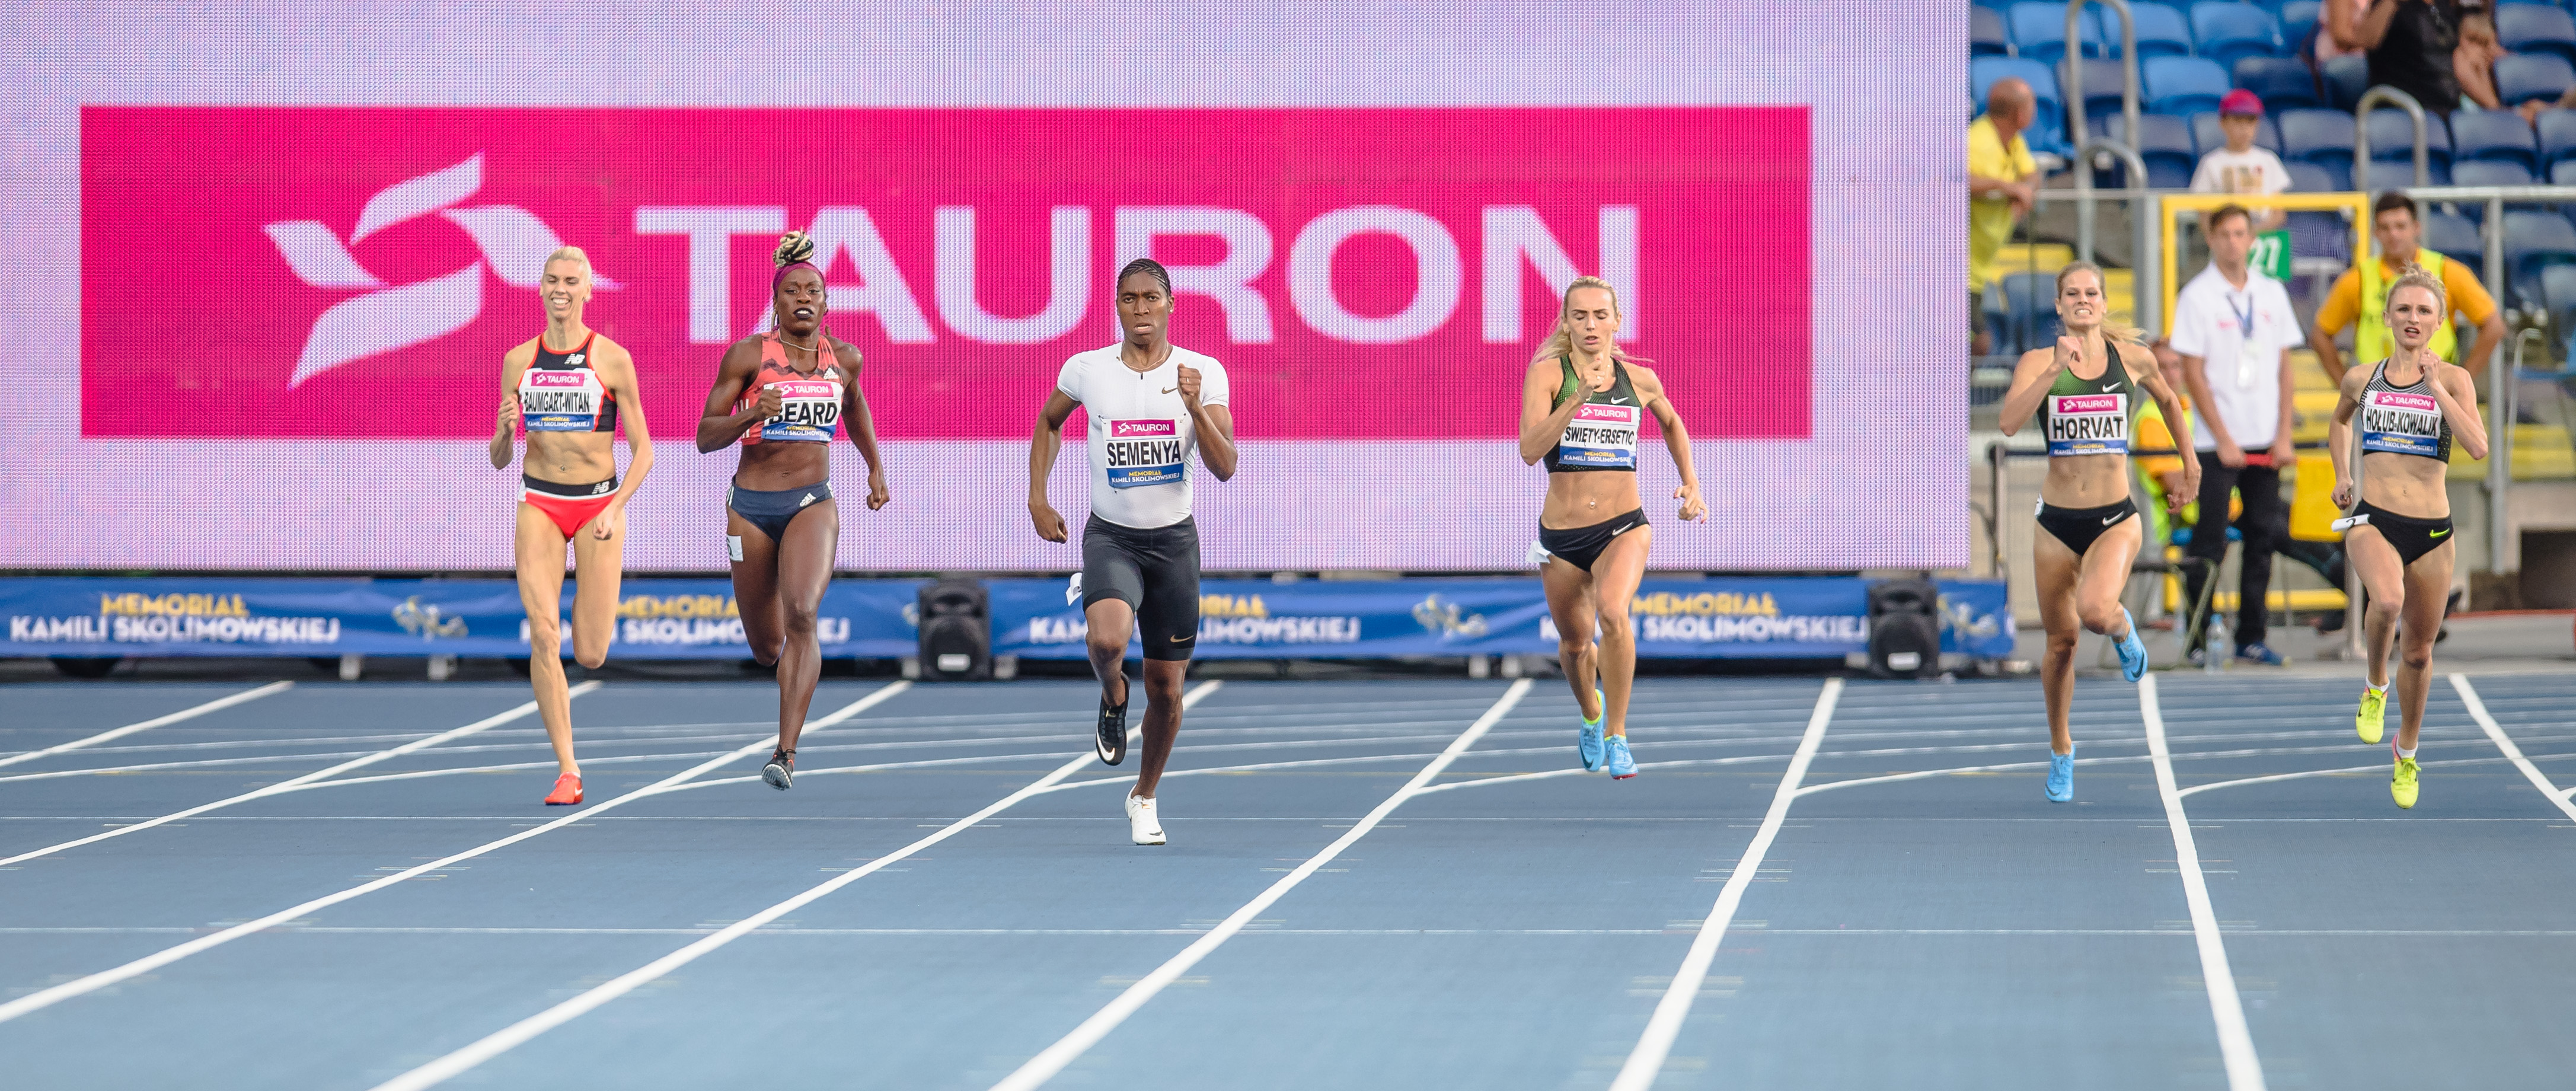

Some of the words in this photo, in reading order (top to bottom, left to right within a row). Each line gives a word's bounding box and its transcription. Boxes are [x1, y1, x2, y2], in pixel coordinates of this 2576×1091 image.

[634, 205, 1640, 344] TAURON
[547, 375, 580, 384] TAURON
[524, 391, 590, 412] BAUMGART-WITAN
[2076, 400, 2112, 409] TAURON
[2395, 397, 2431, 407] TAURON
[769, 401, 838, 425] BEARD
[1593, 409, 1628, 419] TAURON
[1131, 423, 1170, 432] TAURON
[2052, 416, 2124, 439] HORVAT
[1106, 440, 1182, 467] SEMENYA
[1132, 473, 1180, 483] SKOLIMOWSKIEJ
[10, 615, 108, 642] KAMILI
[113, 616, 341, 644] SKOLIMOWSKIEJ
[1643, 615, 1871, 642] SKOLIMOWSKIEJ
